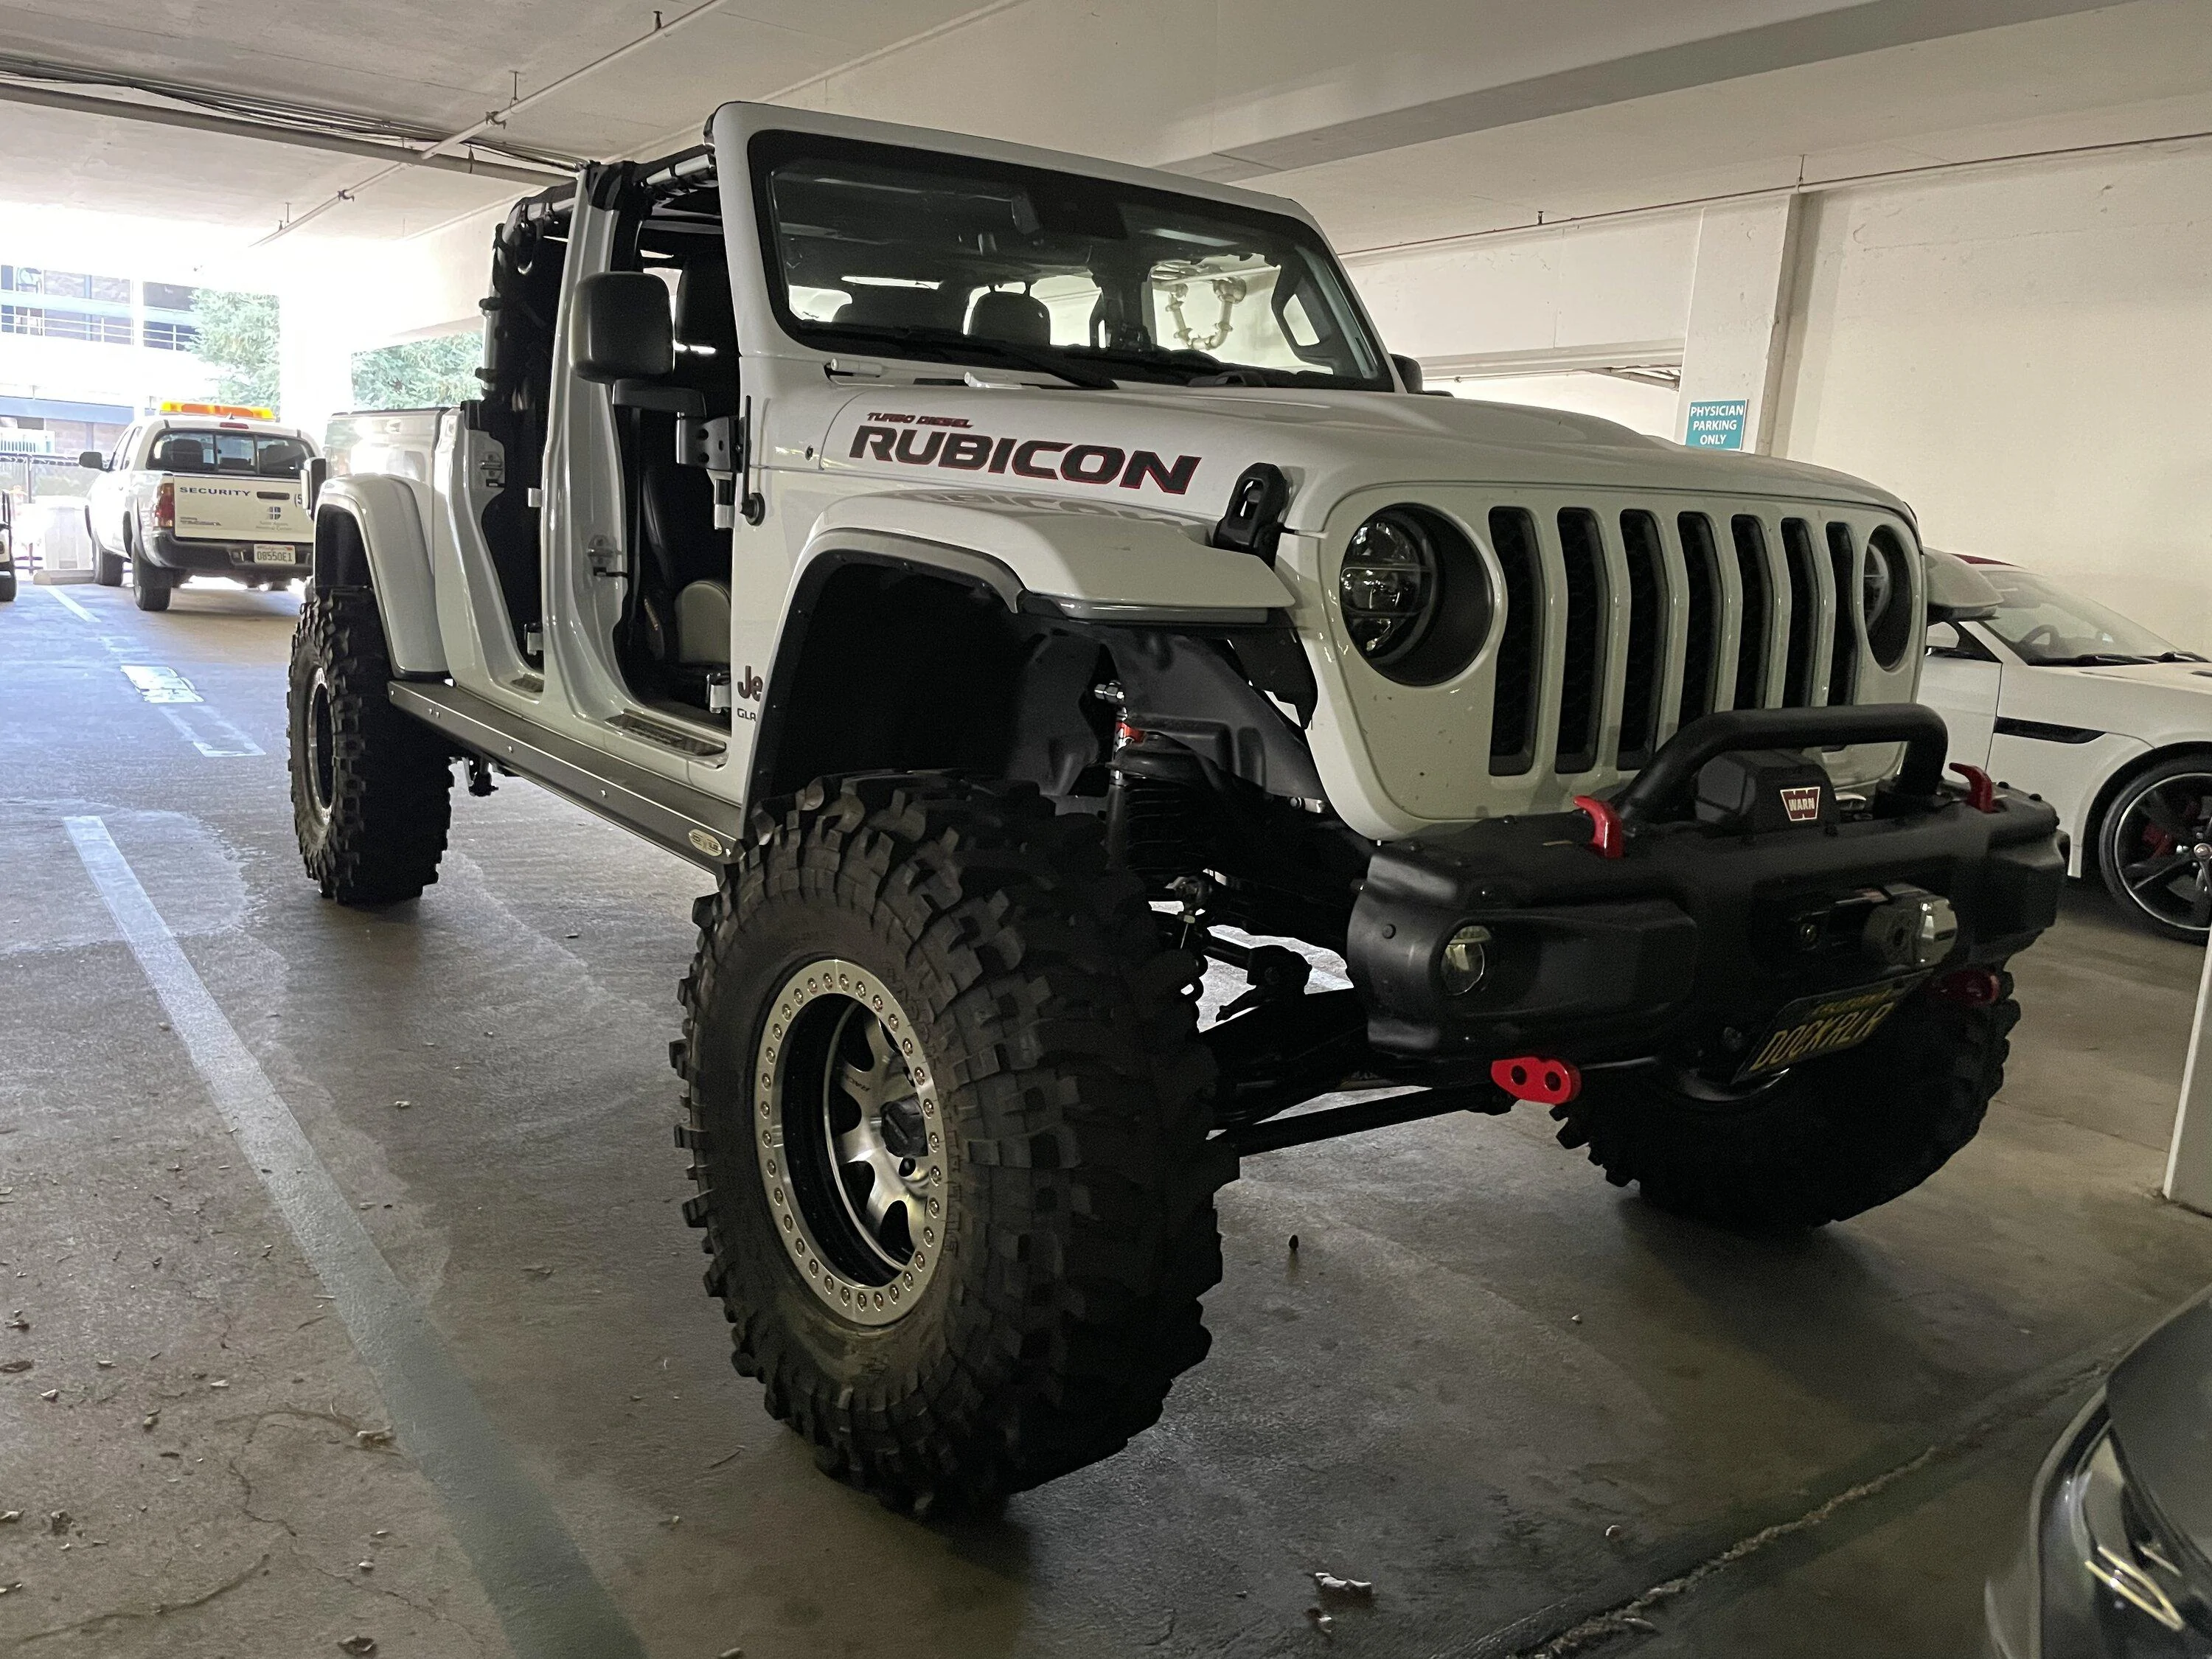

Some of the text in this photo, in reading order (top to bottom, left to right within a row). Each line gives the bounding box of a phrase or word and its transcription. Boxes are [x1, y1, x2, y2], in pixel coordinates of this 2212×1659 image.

[1690, 405, 1745, 417] PHYSICIAN
[866, 412, 974, 428] TURBO DIESEL
[1693, 420, 1738, 431] PARKING
[1700, 434, 1727, 445] ONLY
[849, 425, 1202, 495] RUBICON
[179, 487, 251, 496] SECURITY
[1788, 797, 1815, 812] WARN
